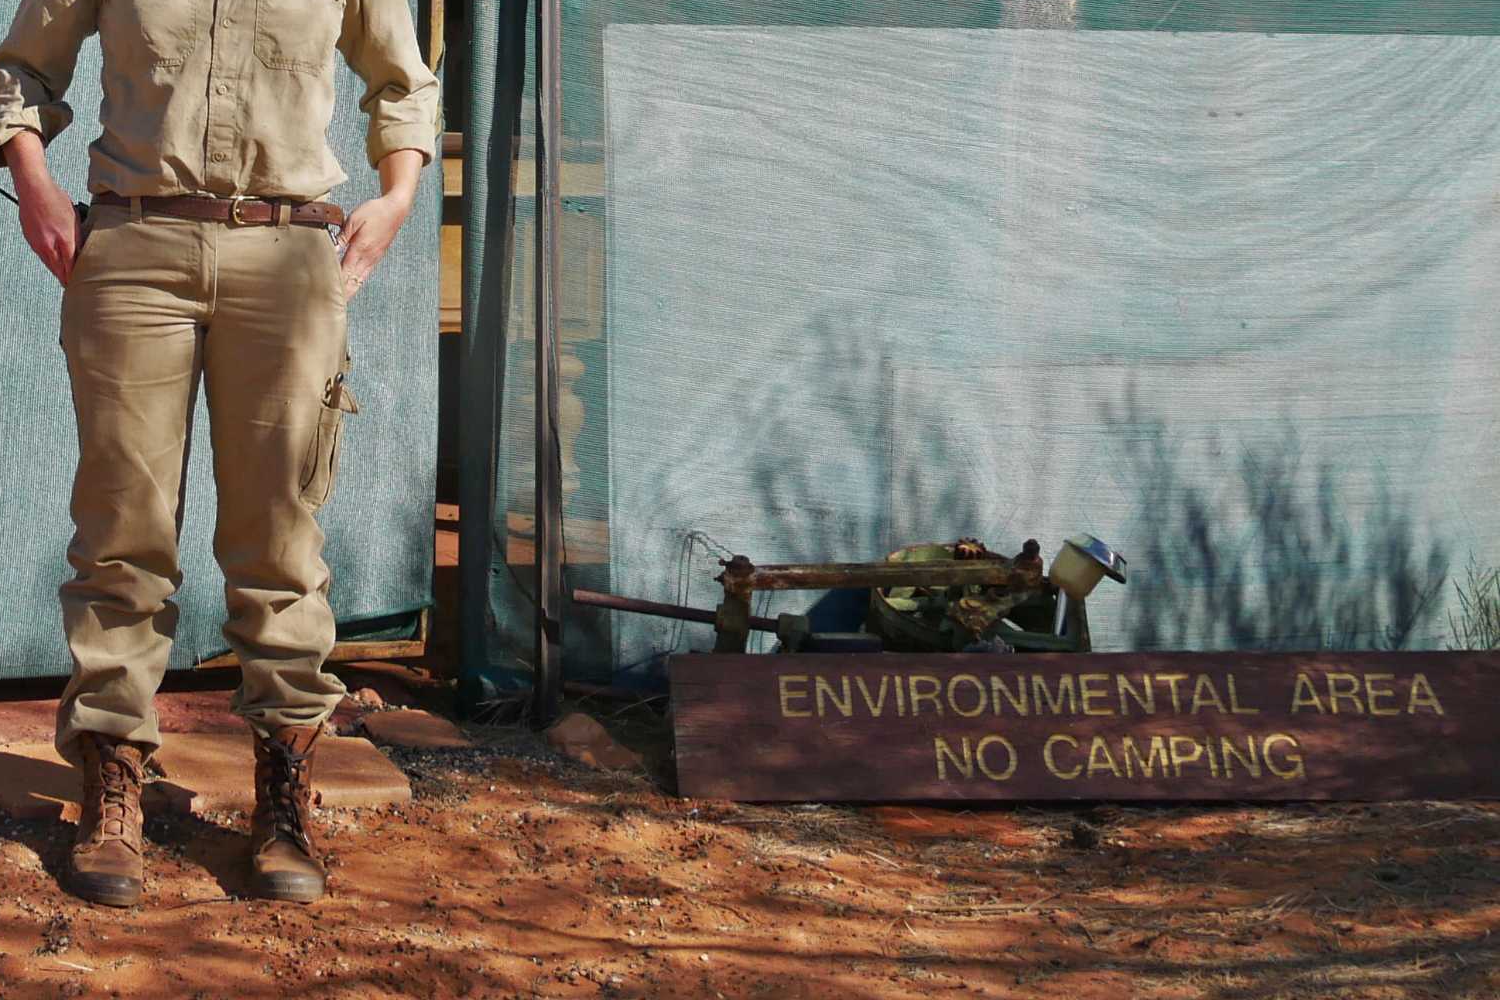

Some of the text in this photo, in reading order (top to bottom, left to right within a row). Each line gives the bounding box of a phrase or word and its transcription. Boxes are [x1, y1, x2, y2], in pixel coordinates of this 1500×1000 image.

[778, 672, 1446, 719] ENVIRONMENTAL AREA
[932, 732, 1307, 781] NO CAMPING
